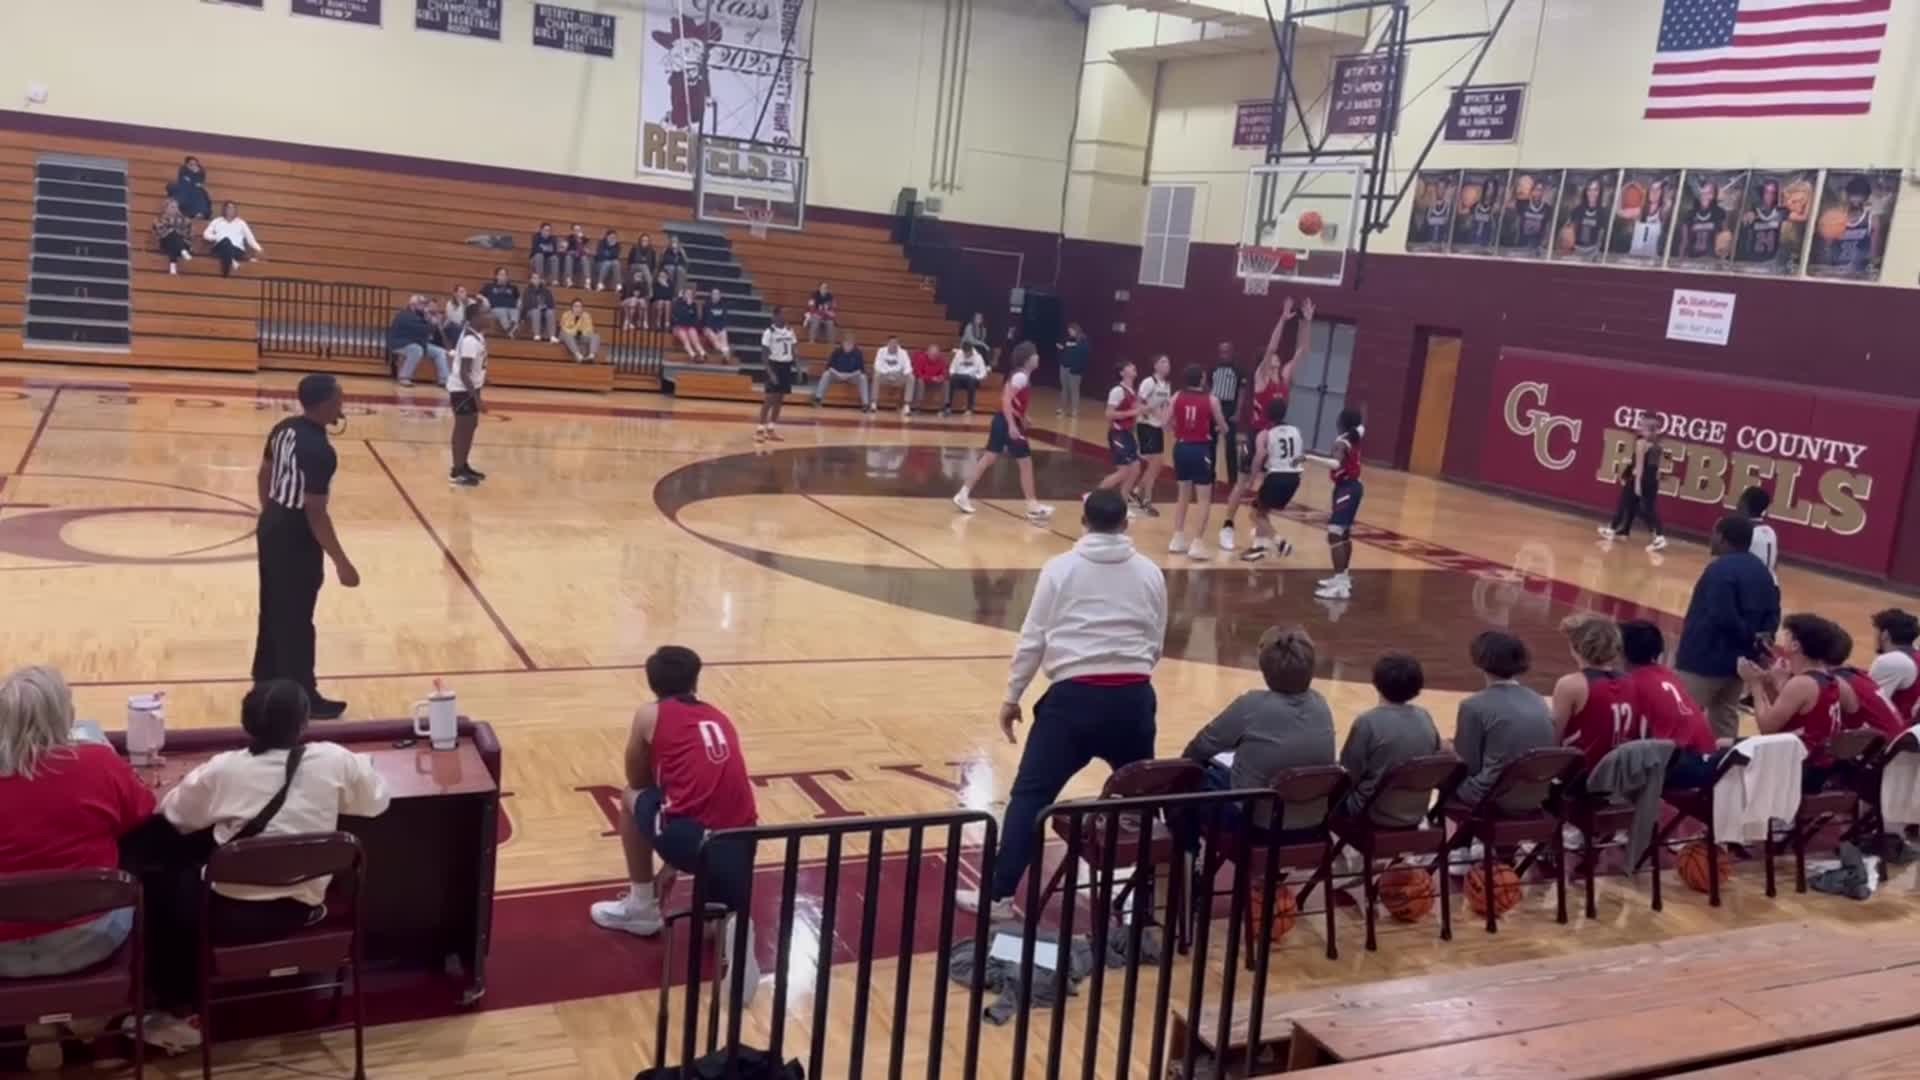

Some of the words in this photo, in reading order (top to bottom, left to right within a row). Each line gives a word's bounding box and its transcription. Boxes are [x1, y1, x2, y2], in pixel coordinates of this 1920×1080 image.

[770, 136, 789, 181] SCOO
[1278, 437, 1295, 459] 31
[1614, 405, 1728, 445] GEORGE
[1736, 425, 1868, 469] COUNTY
[1596, 428, 1873, 536] REBELS
